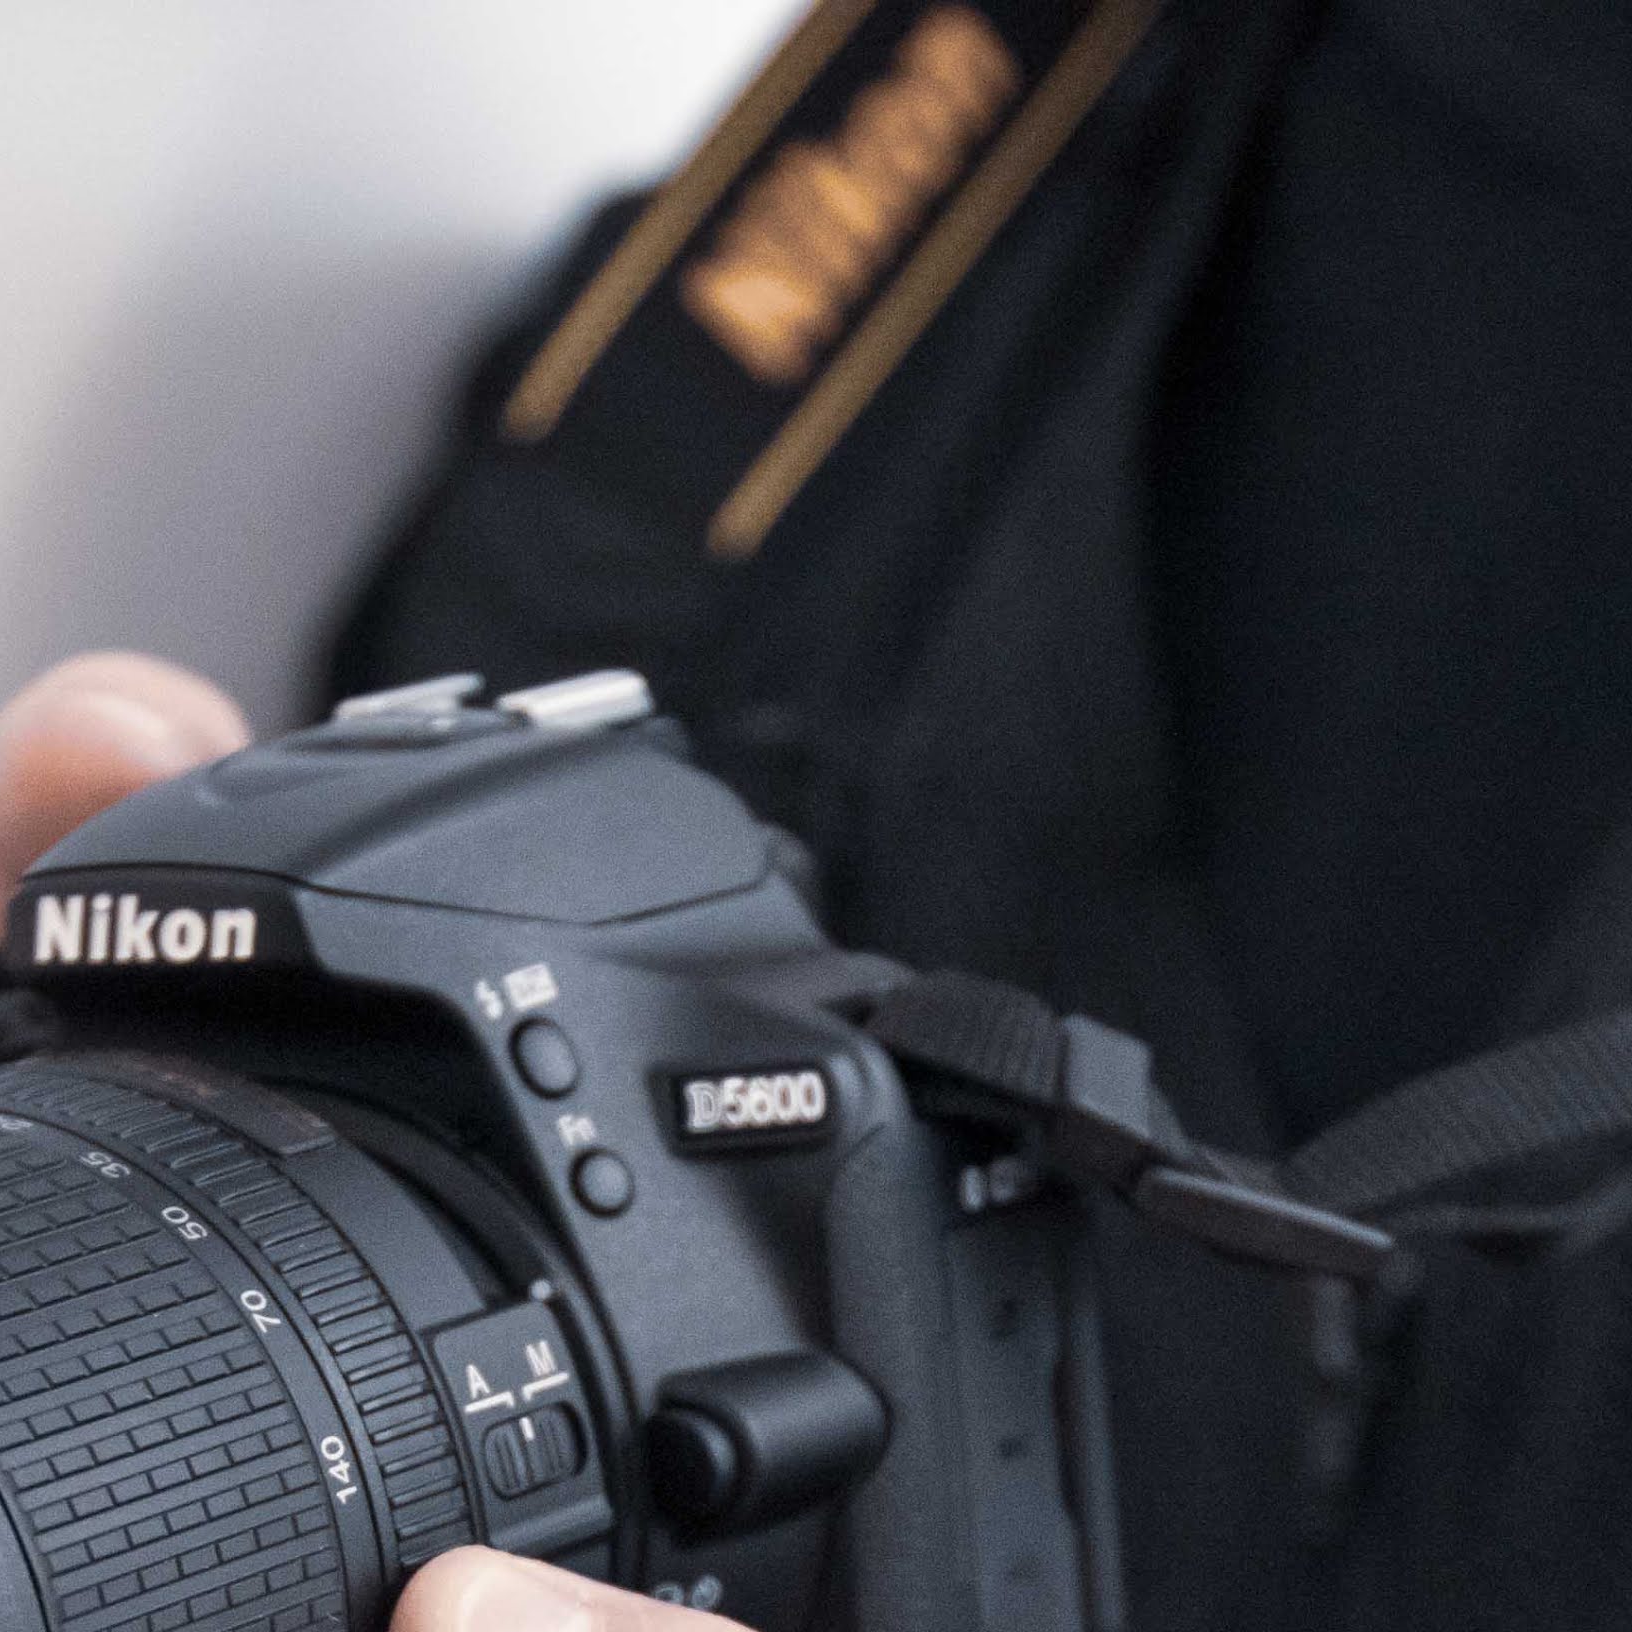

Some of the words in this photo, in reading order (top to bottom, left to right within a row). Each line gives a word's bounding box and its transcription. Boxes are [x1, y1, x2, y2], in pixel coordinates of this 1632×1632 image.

[33, 893, 258, 965] Nikon
[683, 1069, 828, 1133] D5600
[78, 1150, 131, 1179] 35
[161, 1205, 208, 1241] 50
[240, 1287, 282, 1334] 70
[467, 1364, 491, 1399] A
[525, 1340, 558, 1378] M
[320, 1434, 358, 1505] 140
